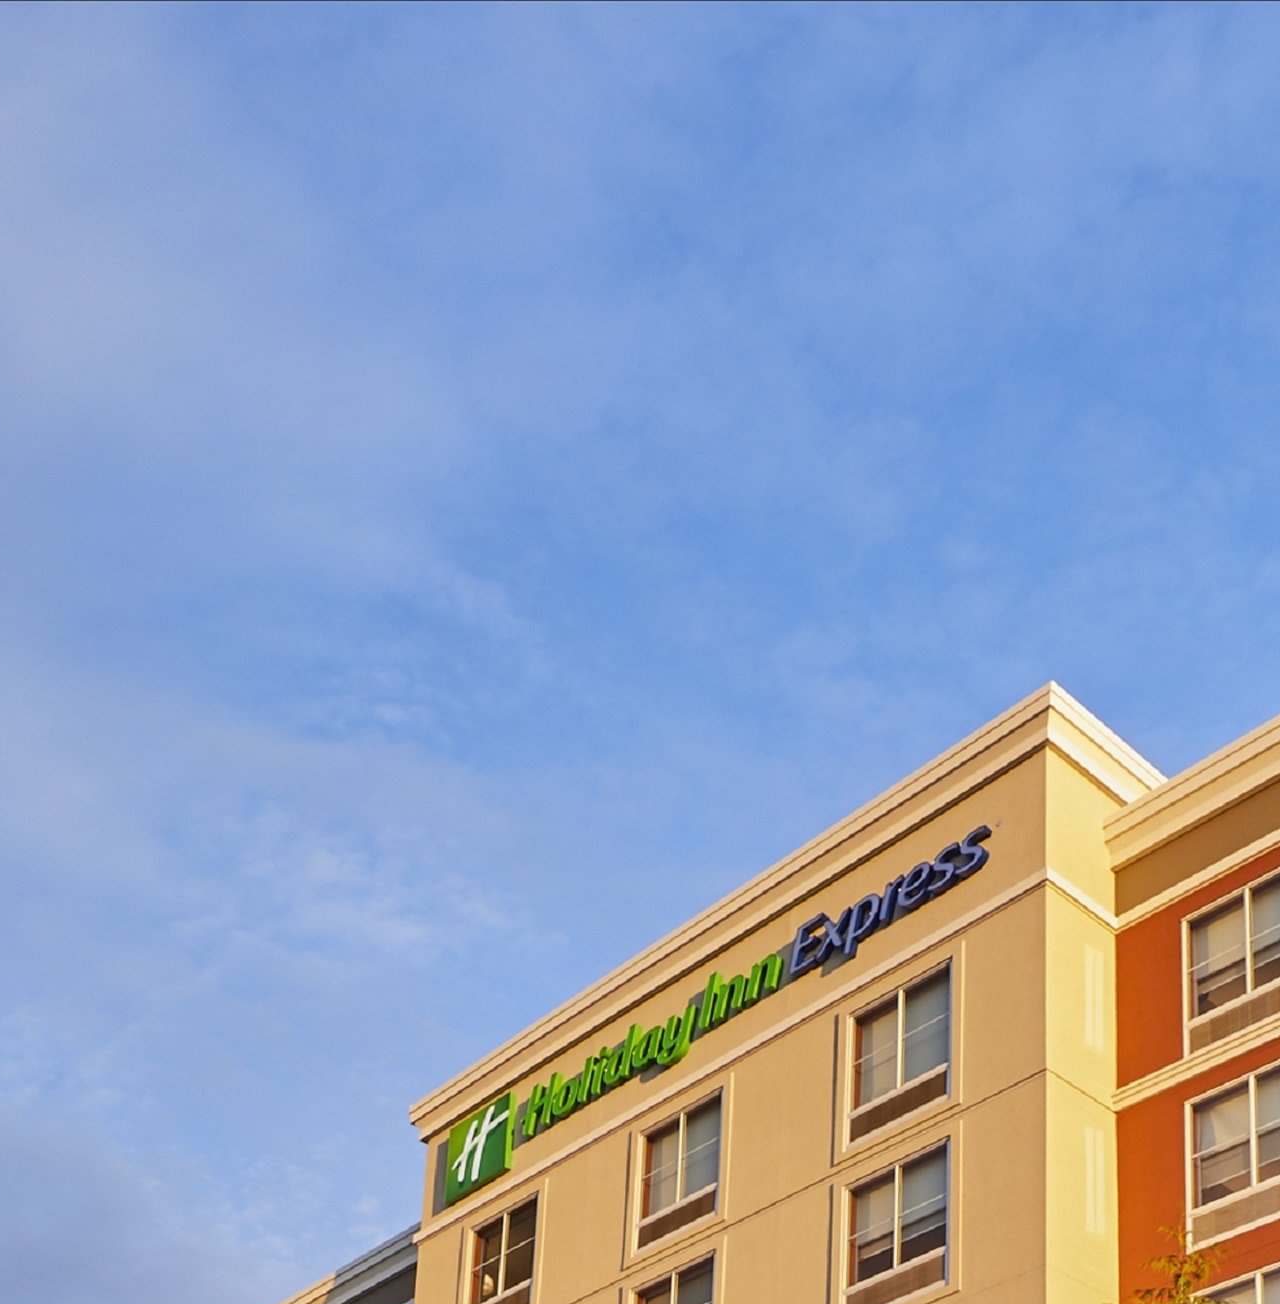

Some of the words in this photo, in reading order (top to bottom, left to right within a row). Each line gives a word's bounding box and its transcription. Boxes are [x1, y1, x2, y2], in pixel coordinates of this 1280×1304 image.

[452, 1105, 510, 1183] H
[521, 1004, 697, 1136] Holiday
[699, 953, 784, 1030] Inn
[789, 825, 993, 975] Express
